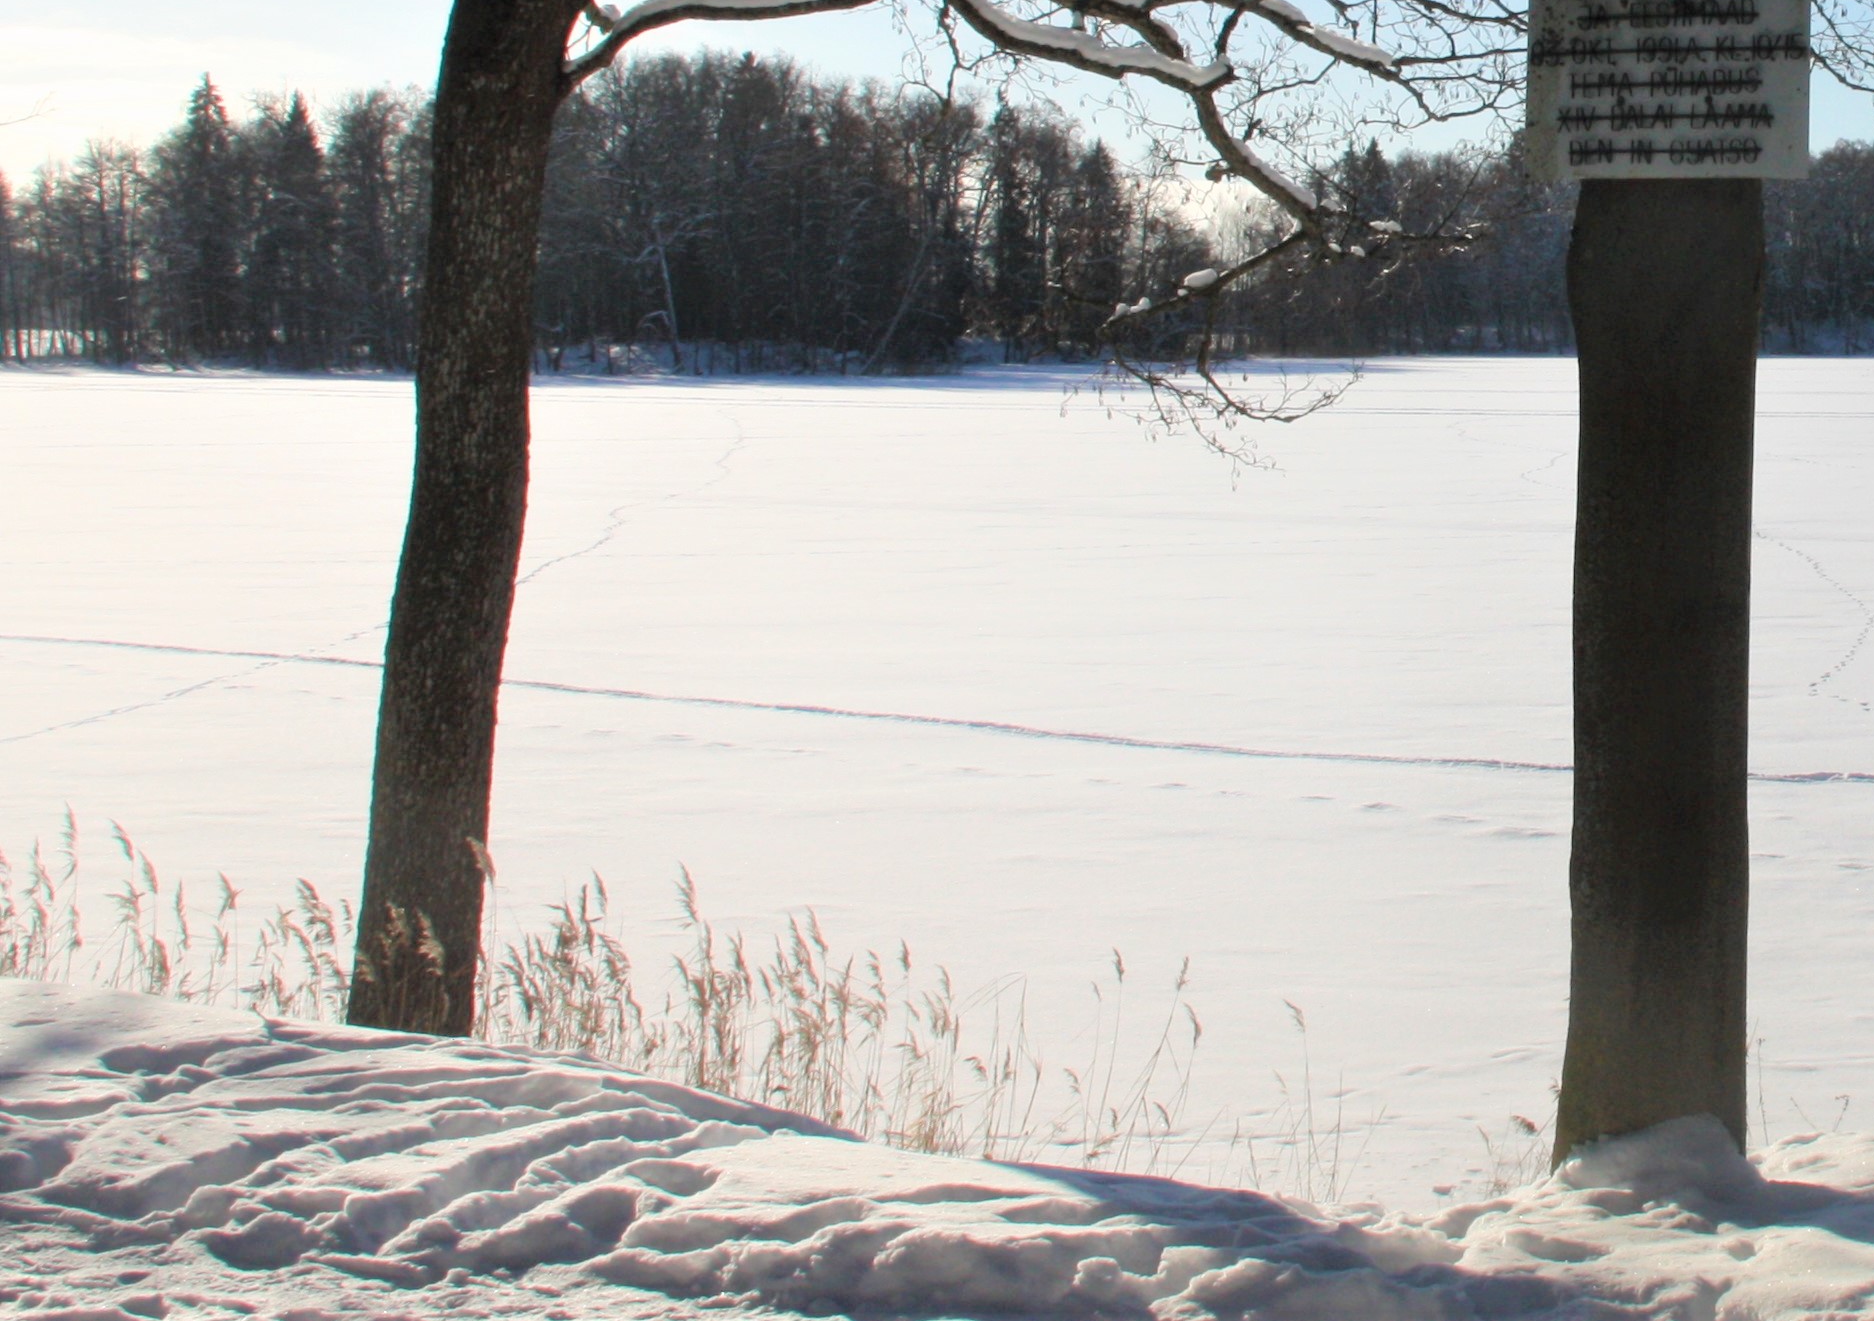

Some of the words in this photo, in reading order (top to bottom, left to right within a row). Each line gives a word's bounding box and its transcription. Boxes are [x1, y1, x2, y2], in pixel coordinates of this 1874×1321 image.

[1570, 70, 1633, 98] TEMA
[1557, 106, 1597, 133] XIV
[1610, 104, 1674, 131] DALAI
[1690, 103, 1774, 129] LAAMA
